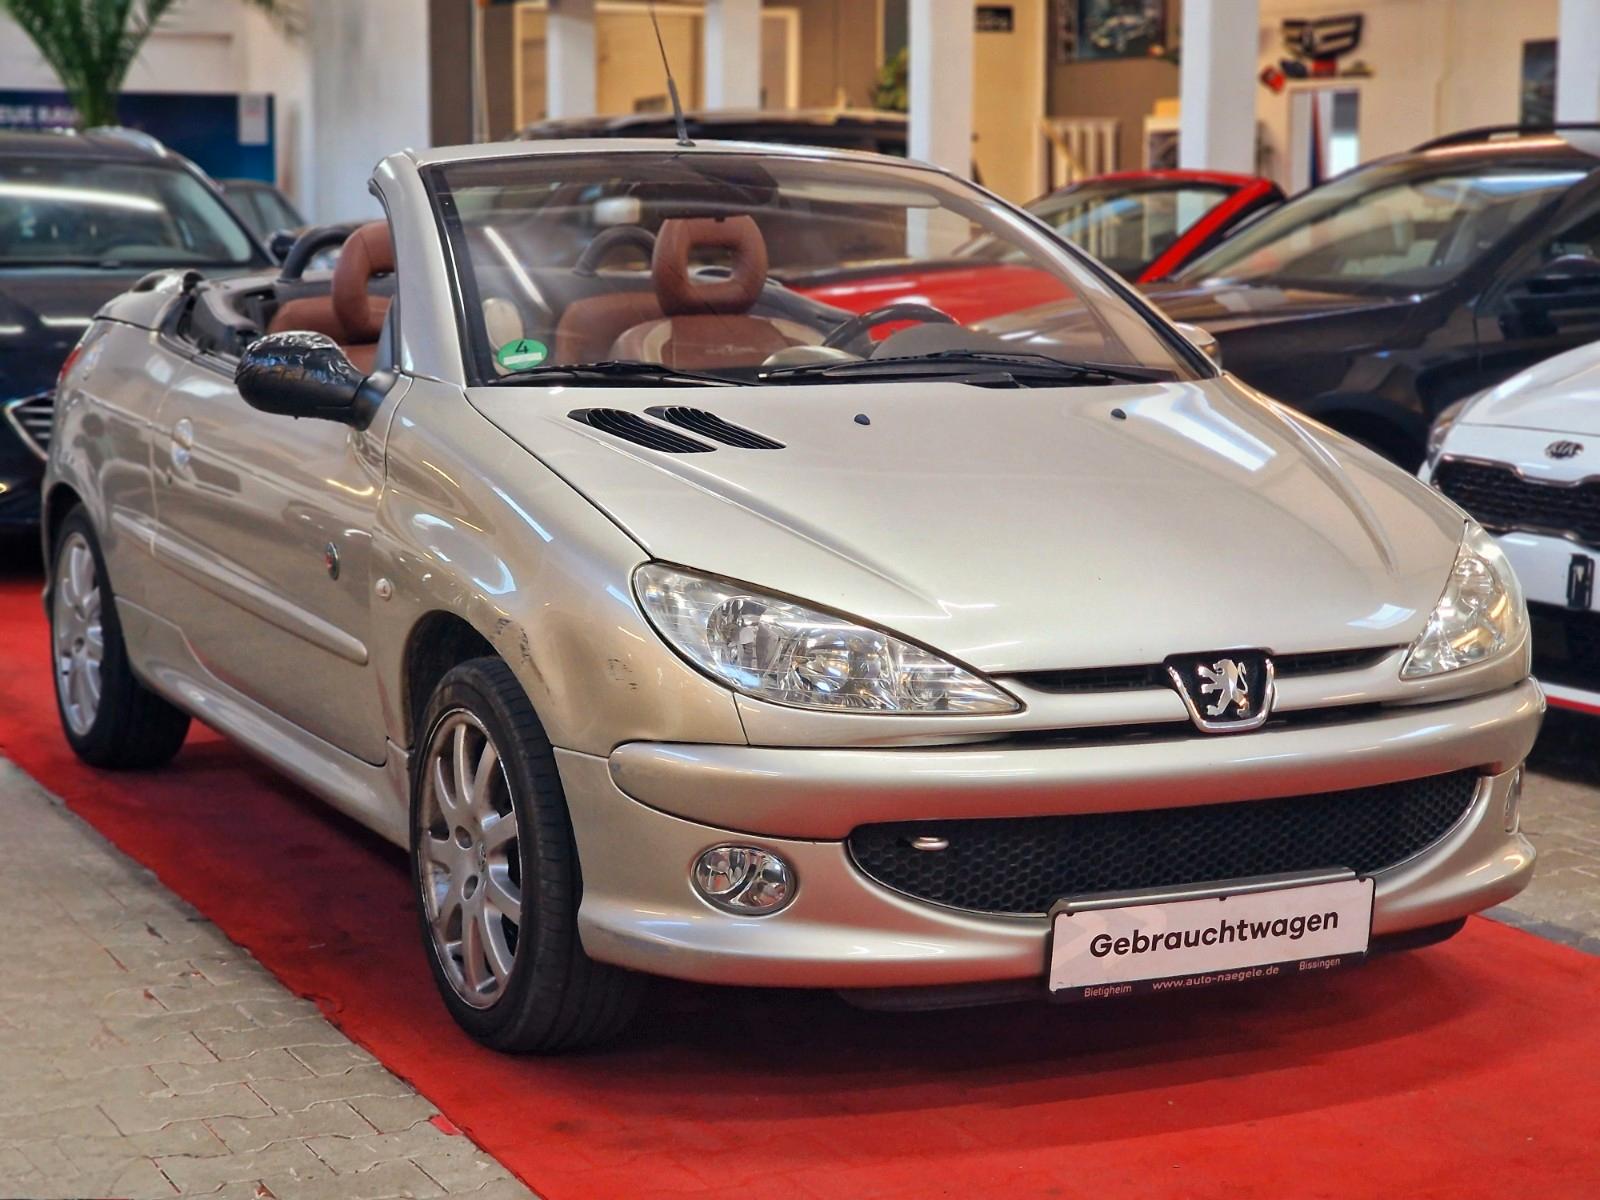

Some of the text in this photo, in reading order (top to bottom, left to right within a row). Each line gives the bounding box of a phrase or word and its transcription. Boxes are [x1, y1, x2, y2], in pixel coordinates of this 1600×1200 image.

[515, 340, 528, 354] 4
[1090, 911, 1338, 957] Gebrauchtwagen
[1084, 958, 1341, 997] Bietigheim www.auto-naegele.de Bissingen
